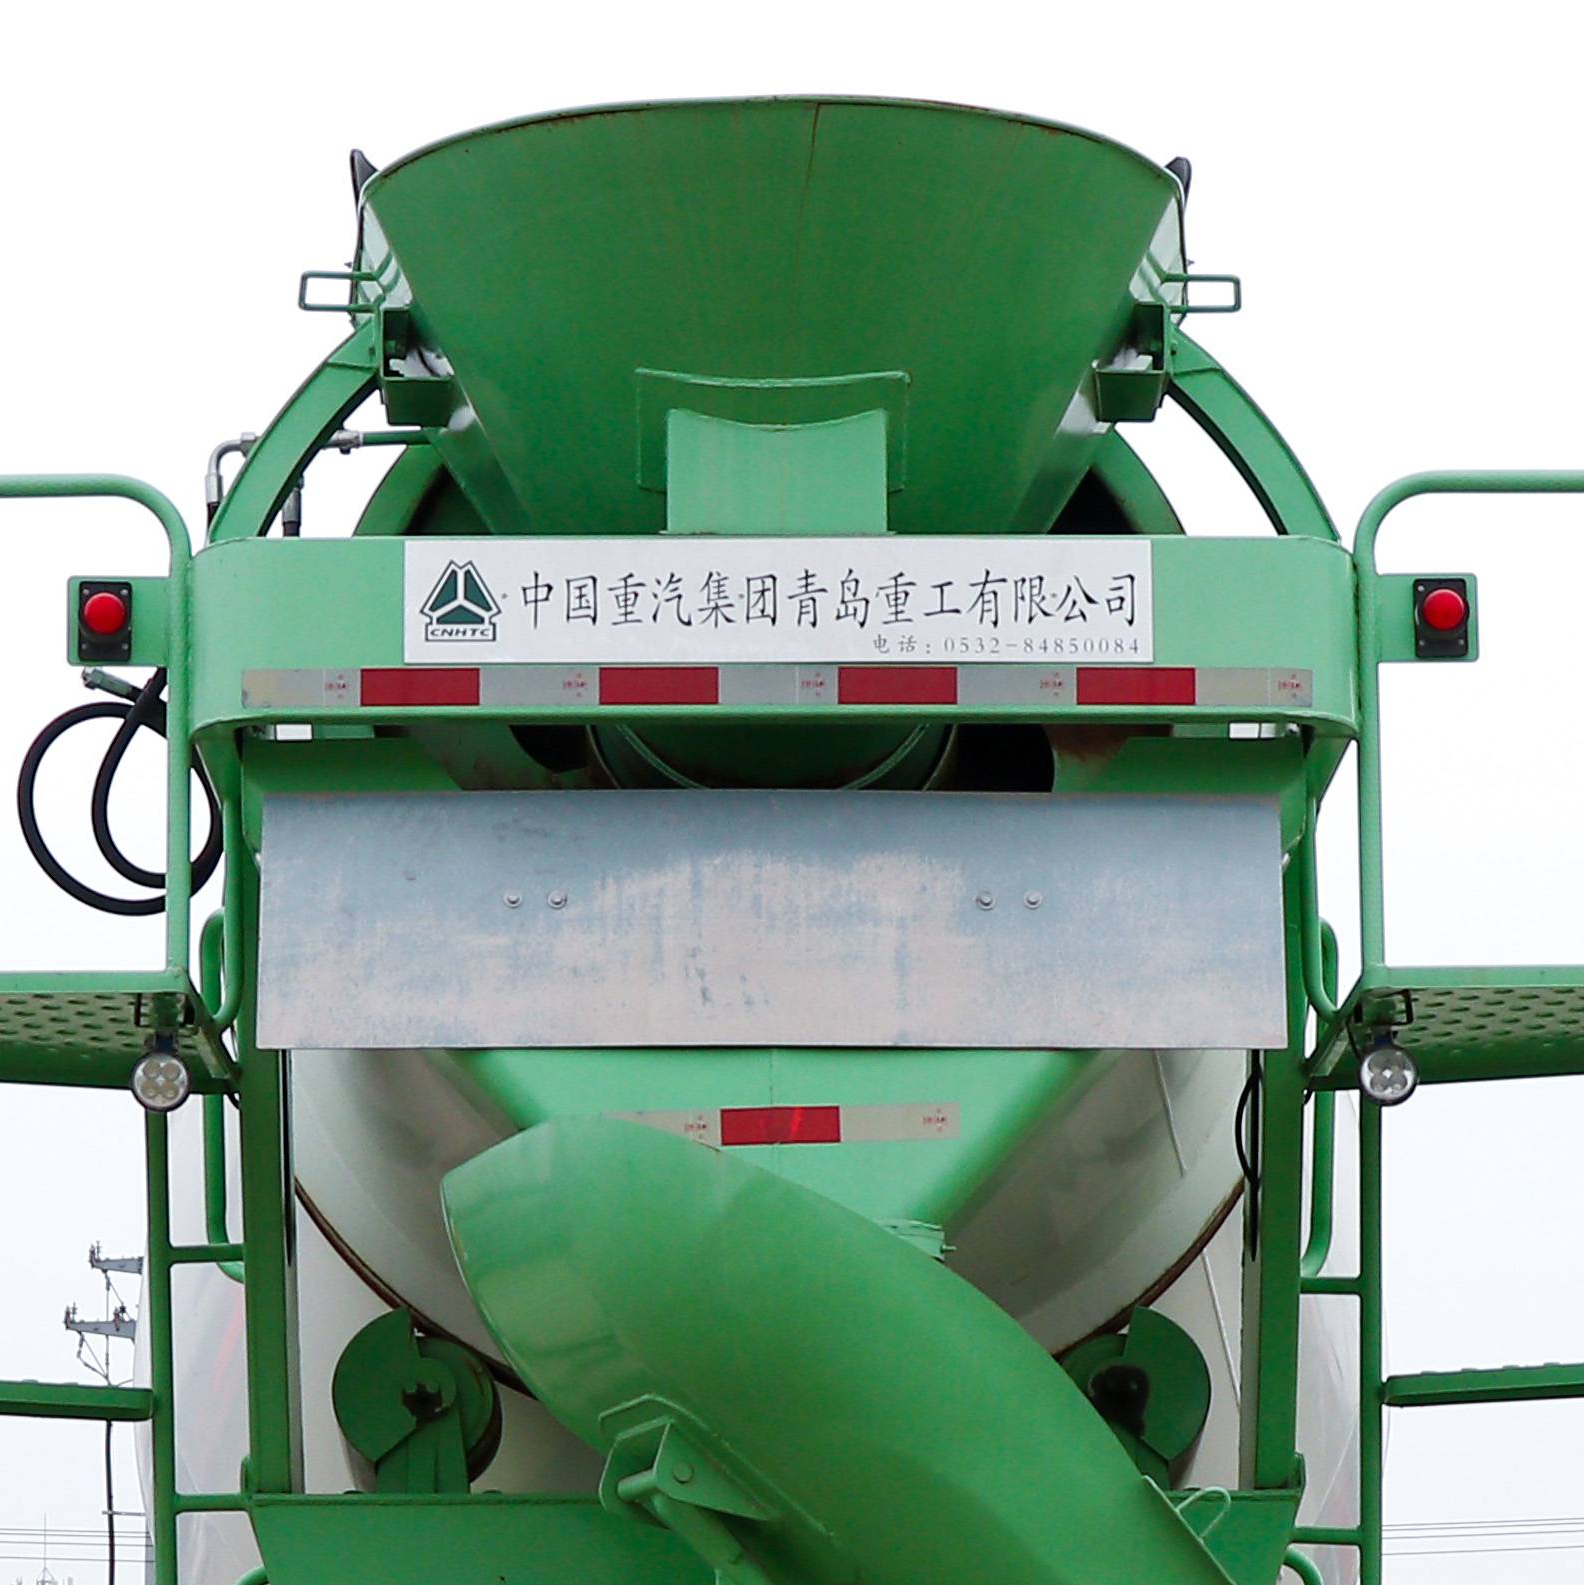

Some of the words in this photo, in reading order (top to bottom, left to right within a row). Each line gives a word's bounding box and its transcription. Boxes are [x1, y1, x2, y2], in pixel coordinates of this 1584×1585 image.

[520, 569, 1136, 630] 中国重汽集团青岛重工有限公司
[430, 628, 490, 637] CNHTC
